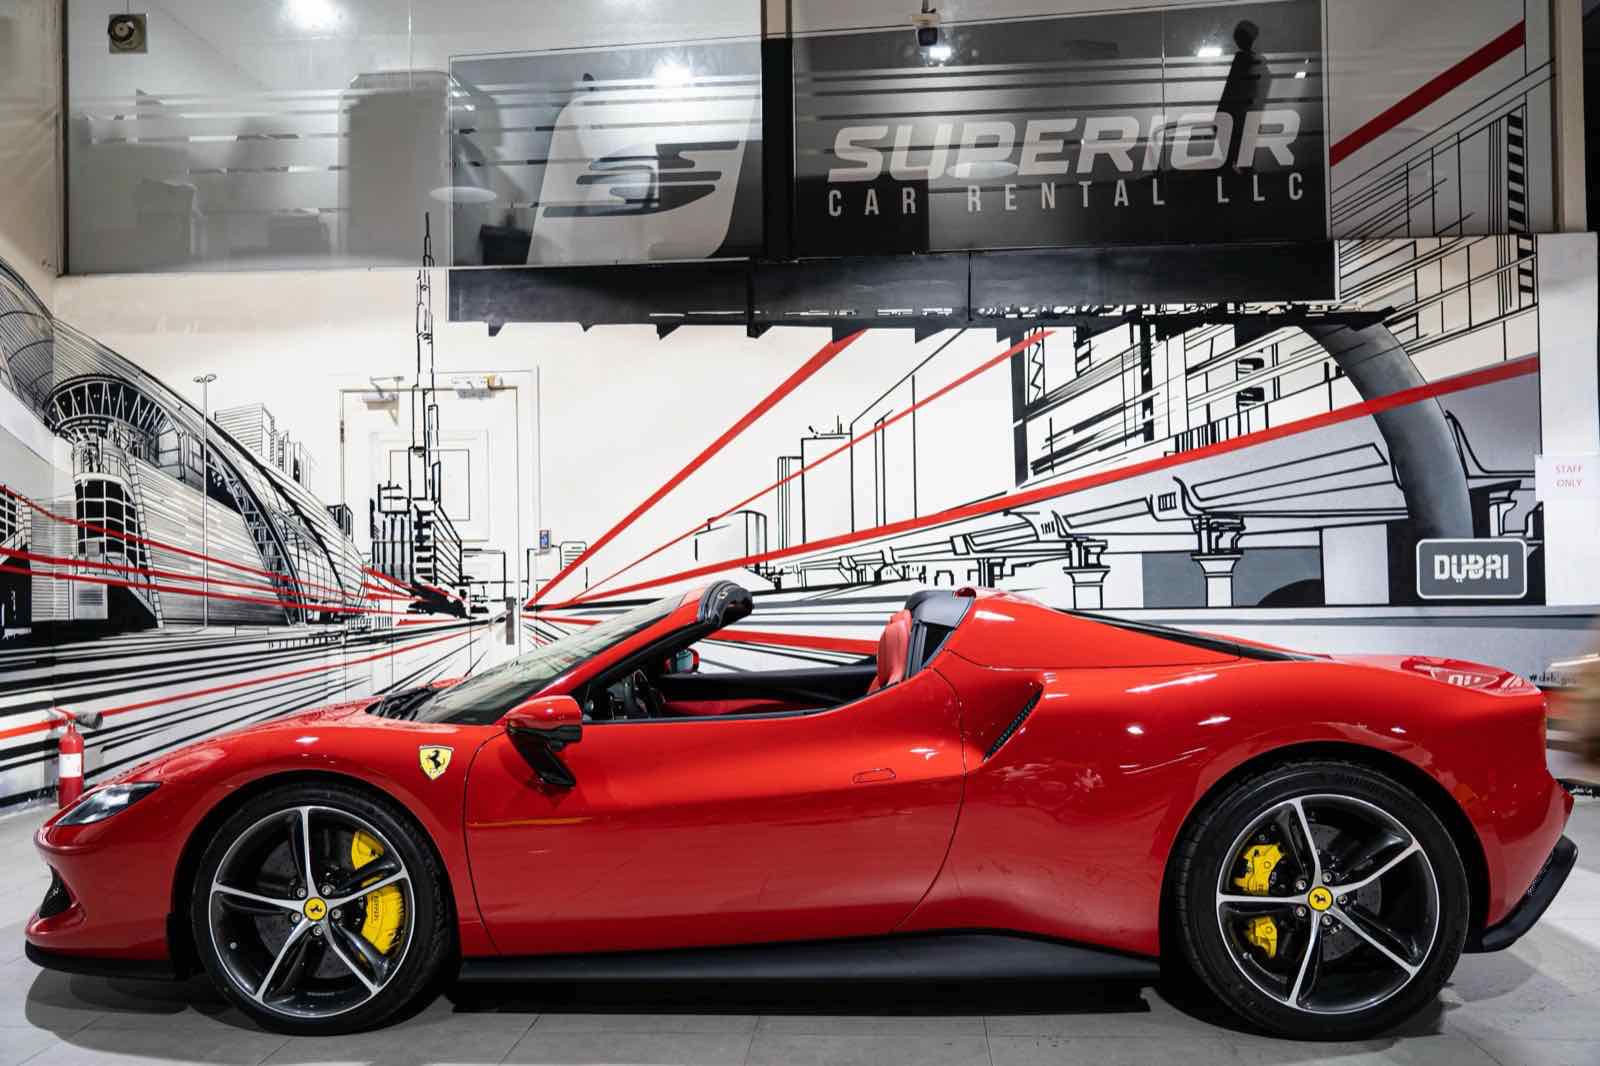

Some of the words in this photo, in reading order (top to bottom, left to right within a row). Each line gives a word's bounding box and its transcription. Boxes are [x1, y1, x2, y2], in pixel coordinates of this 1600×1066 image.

[827, 109, 1301, 183] SUPERIOR
[829, 189, 916, 217] CAR
[968, 180, 1165, 213] RENTAL
[1217, 173, 1304, 203] LLC
[1555, 463, 1583, 473] STAFF
[1556, 479, 1583, 488] ONLY
[1434, 554, 1509, 583] DUBAI
